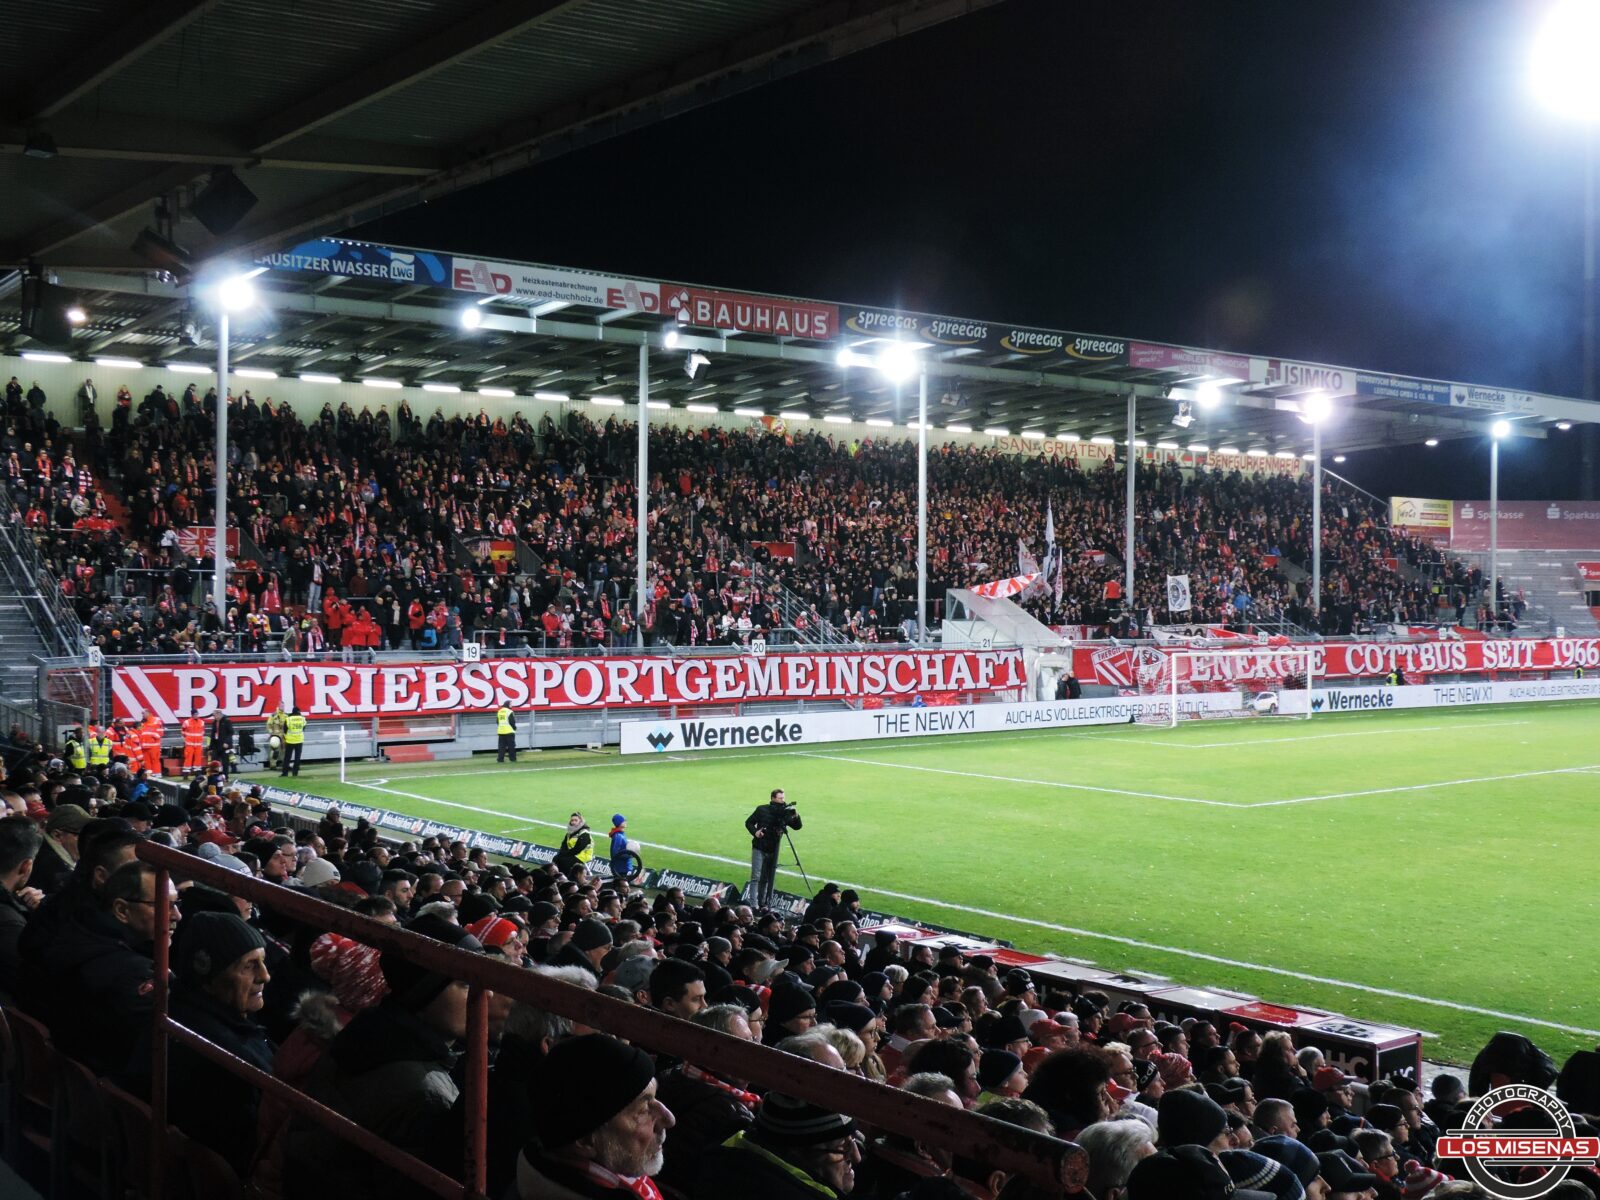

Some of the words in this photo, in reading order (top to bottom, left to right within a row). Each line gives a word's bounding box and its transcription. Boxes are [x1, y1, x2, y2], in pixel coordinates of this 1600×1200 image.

[254, 252, 331, 271] AUSITZER
[332, 258, 389, 279] WASSER
[391, 267, 414, 279] LWG
[454, 262, 513, 295] EAD
[522, 275, 598, 293] Heizkostenabrechnung
[515, 287, 604, 304] www.ead-buchholz.de
[606, 282, 659, 312] EAD
[697, 300, 828, 335] BAUHAUS
[1284, 365, 1343, 391] ISIMKO
[1467, 386, 1506, 403] Wernecke
[752, 642, 765, 655] 20
[982, 638, 991, 648] 21
[1259, 634, 1267, 643] 22
[466, 645, 478, 659] 19
[1189, 644, 1327, 682] ENERGIE
[1344, 641, 1467, 675] COTTBUS
[1481, 640, 1537, 668] SEIT
[1550, 638, 1600, 667] 1966
[172, 650, 1023, 718] BETRIEBSSPORTGEMEINSCHAFT
[1434, 688, 1456, 704] THE
[1458, 686, 1482, 703] NEW
[1483, 686, 1493, 701] X1
[1327, 689, 1394, 710] Wernecke
[873, 713, 911, 734] THE
[915, 711, 955, 732] NEW
[957, 710, 976, 729] X1
[1005, 710, 1032, 725] AUCH
[1034, 708, 1052, 722] ALS
[1055, 703, 1144, 721] VOLLELEKTRISCHER
[1158, 699, 1209, 713] ERÄLTLICH
[680, 718, 803, 748] Wernecke
